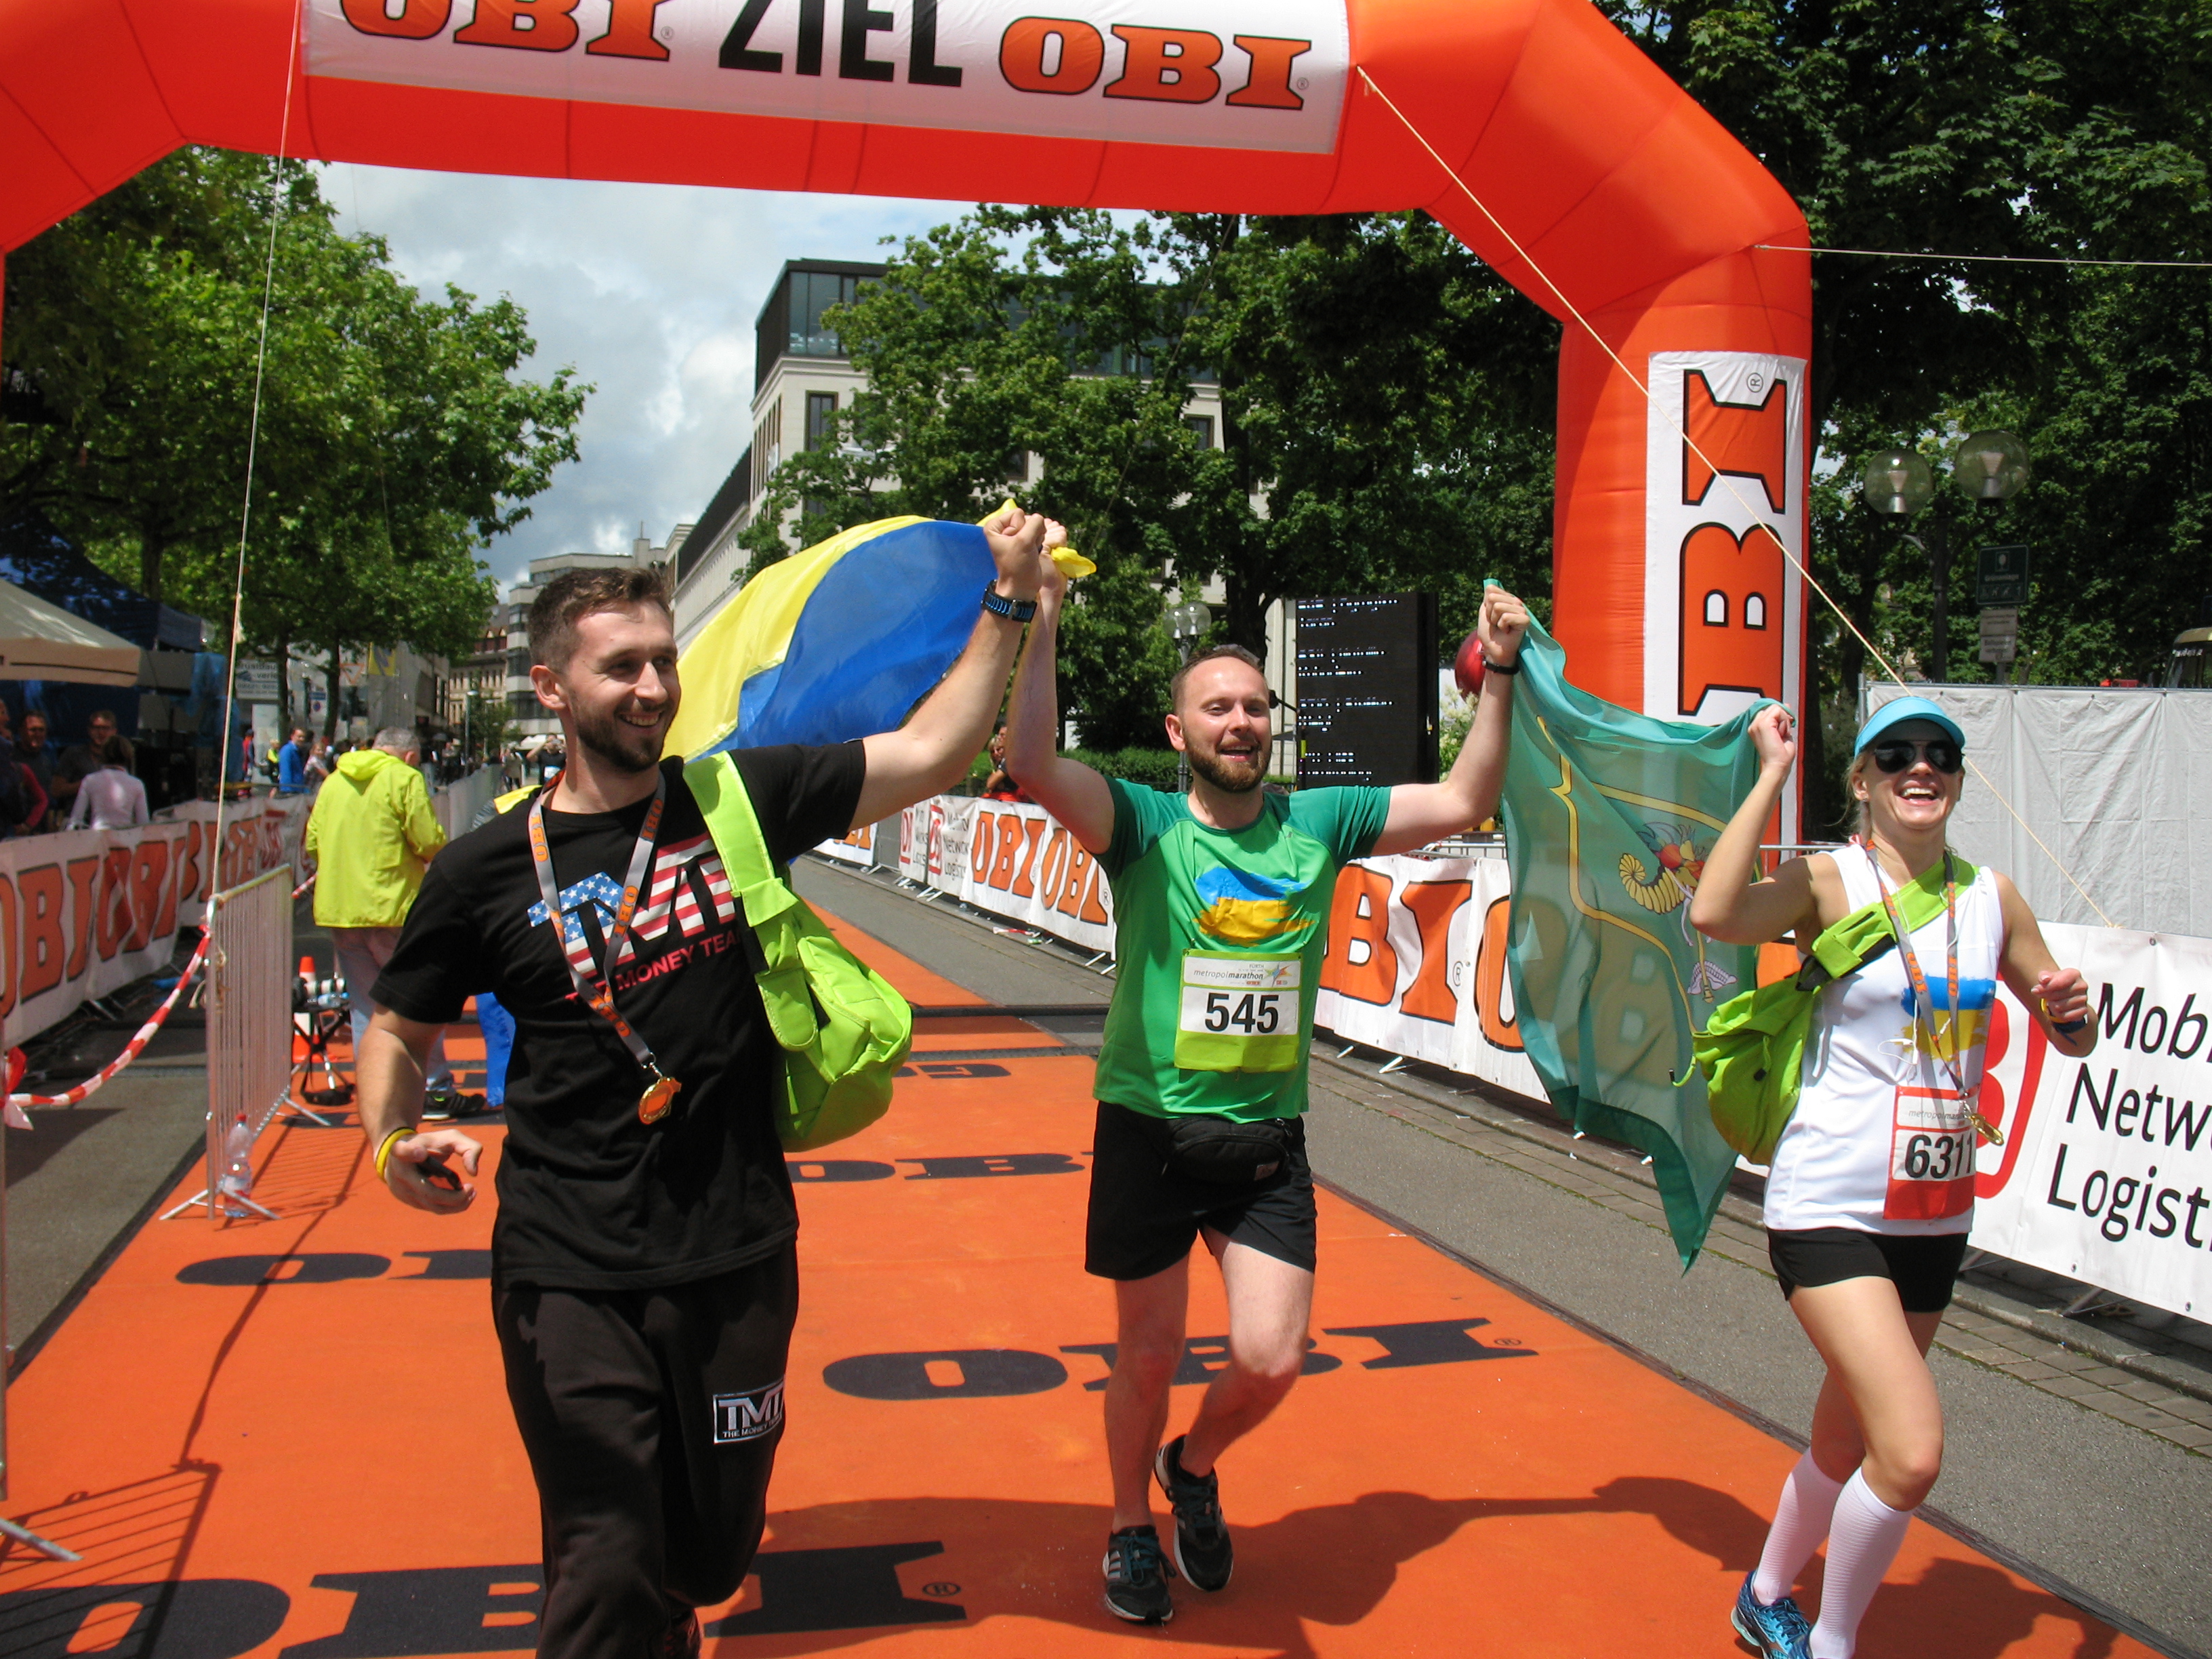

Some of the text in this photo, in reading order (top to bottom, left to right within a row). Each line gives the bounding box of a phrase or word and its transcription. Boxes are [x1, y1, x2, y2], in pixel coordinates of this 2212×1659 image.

[718, 0, 962, 87] ZIEL
[998, 16, 1312, 110] OBI
[1677, 369, 1788, 871] BI
[972, 811, 1046, 898] OBI
[1042, 827, 1108, 926] OBI
[615, 927, 741, 991] MONEY TEA
[1193, 968, 1265, 981] metropolmarathon
[1319, 863, 1474, 1027] BI
[1204, 991, 1279, 1034] 545
[2097, 982, 2212, 1064] Mob
[2066, 1062, 2212, 1152] Netw
[784, 1153, 1094, 1184] OB
[1904, 1132, 1973, 1179] 6311
[2047, 1143, 2212, 1254] Logist
[718, 1382, 783, 1431] TMT
